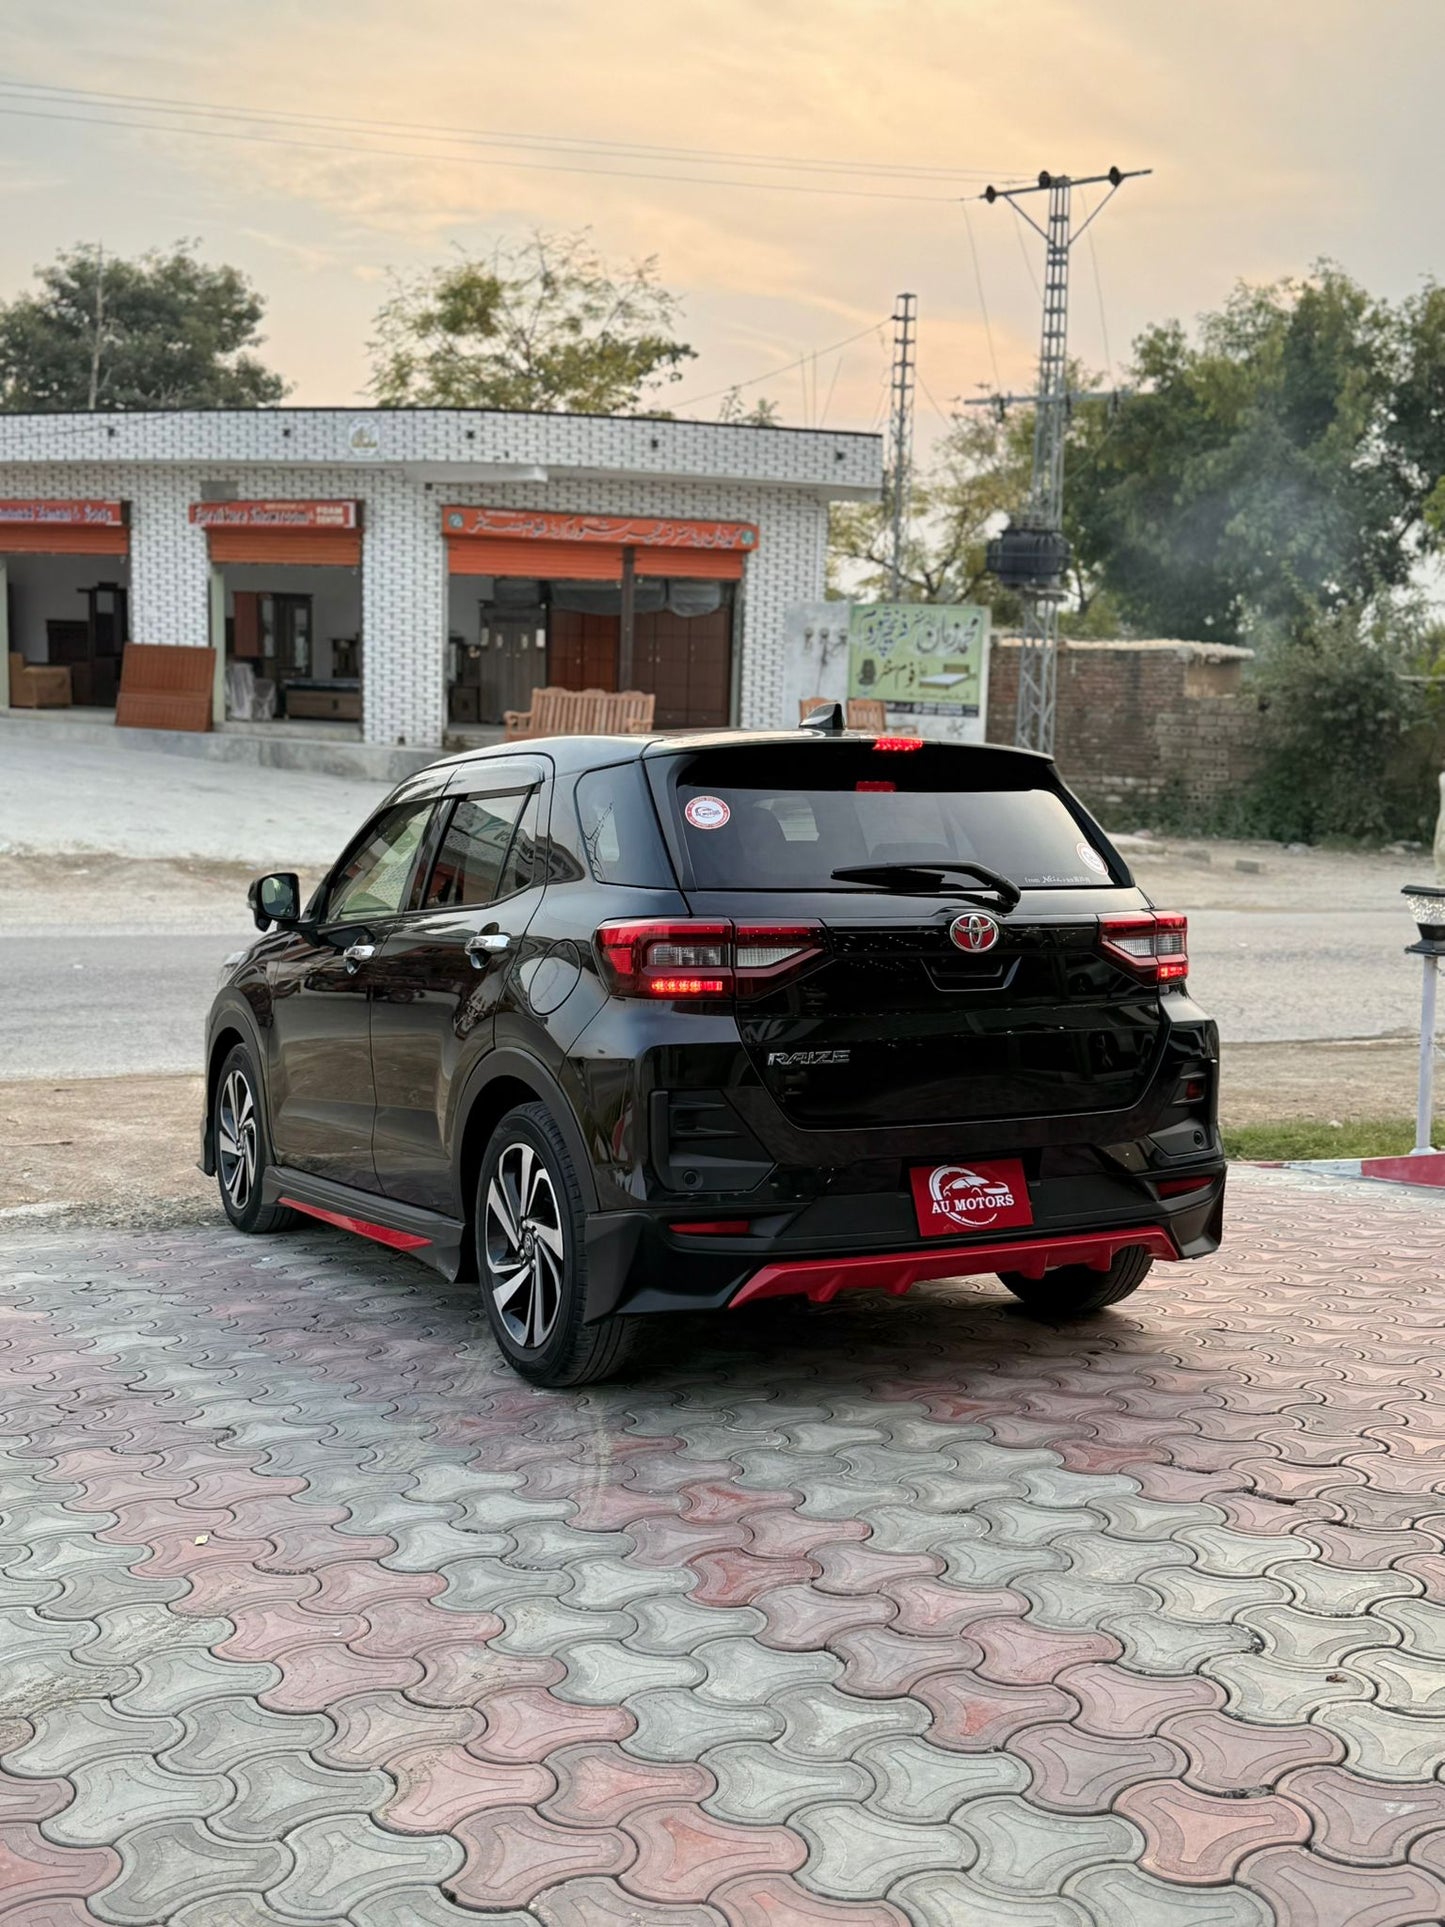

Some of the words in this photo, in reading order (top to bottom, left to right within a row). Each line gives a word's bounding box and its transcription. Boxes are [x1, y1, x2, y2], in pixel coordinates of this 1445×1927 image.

[194, 505, 248, 525] Furniture
[767, 1048, 851, 1067] RAIZE
[931, 1200, 951, 1214] AU
[954, 1193, 1015, 1212] MOTORS
